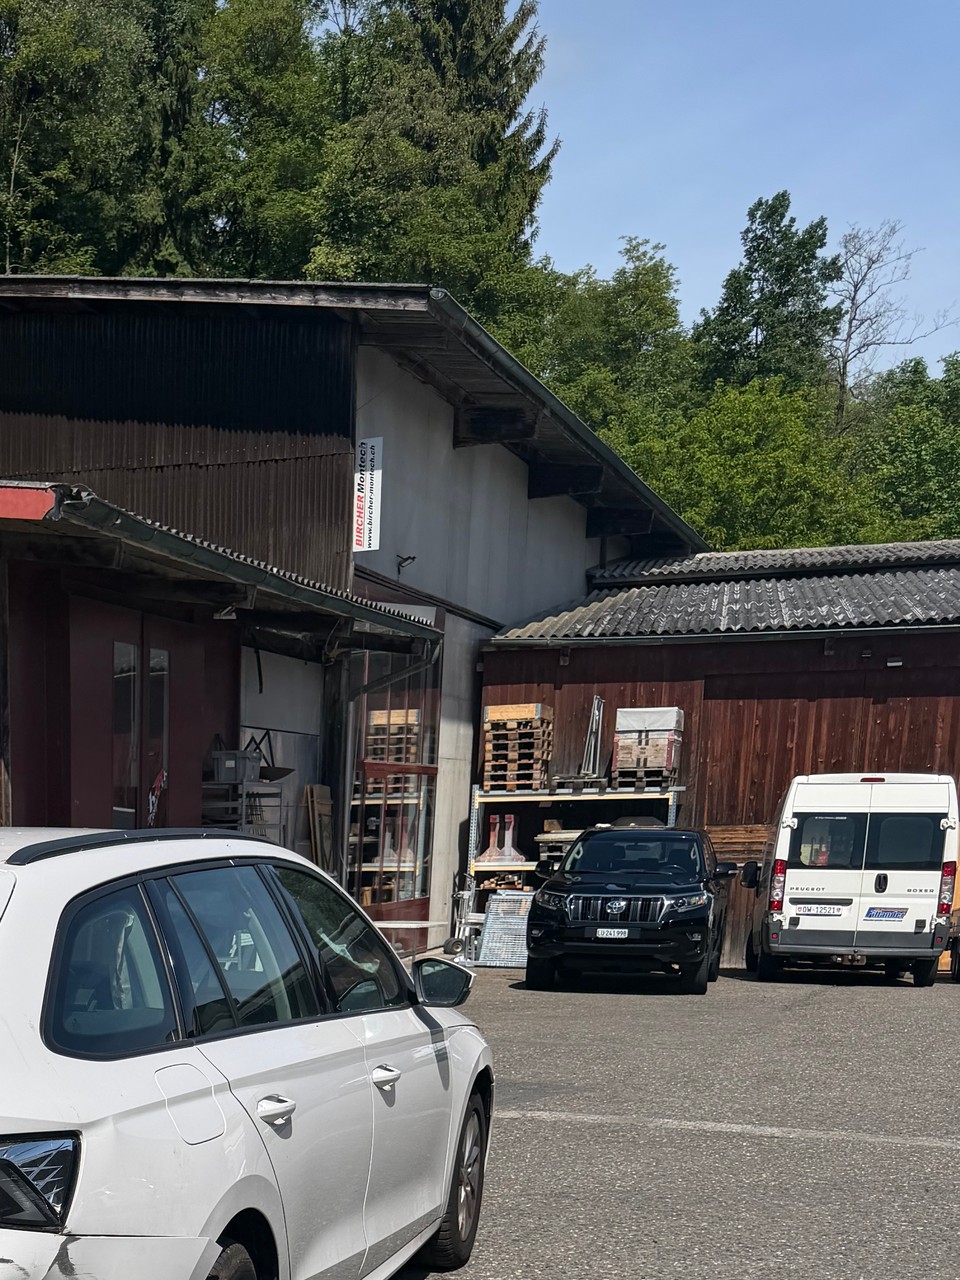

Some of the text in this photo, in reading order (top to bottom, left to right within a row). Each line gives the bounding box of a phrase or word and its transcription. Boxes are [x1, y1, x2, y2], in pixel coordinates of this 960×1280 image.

[355, 442, 366, 548] BIRCHER Montech
[367, 445, 376, 549] www.bircher-montech.ch
